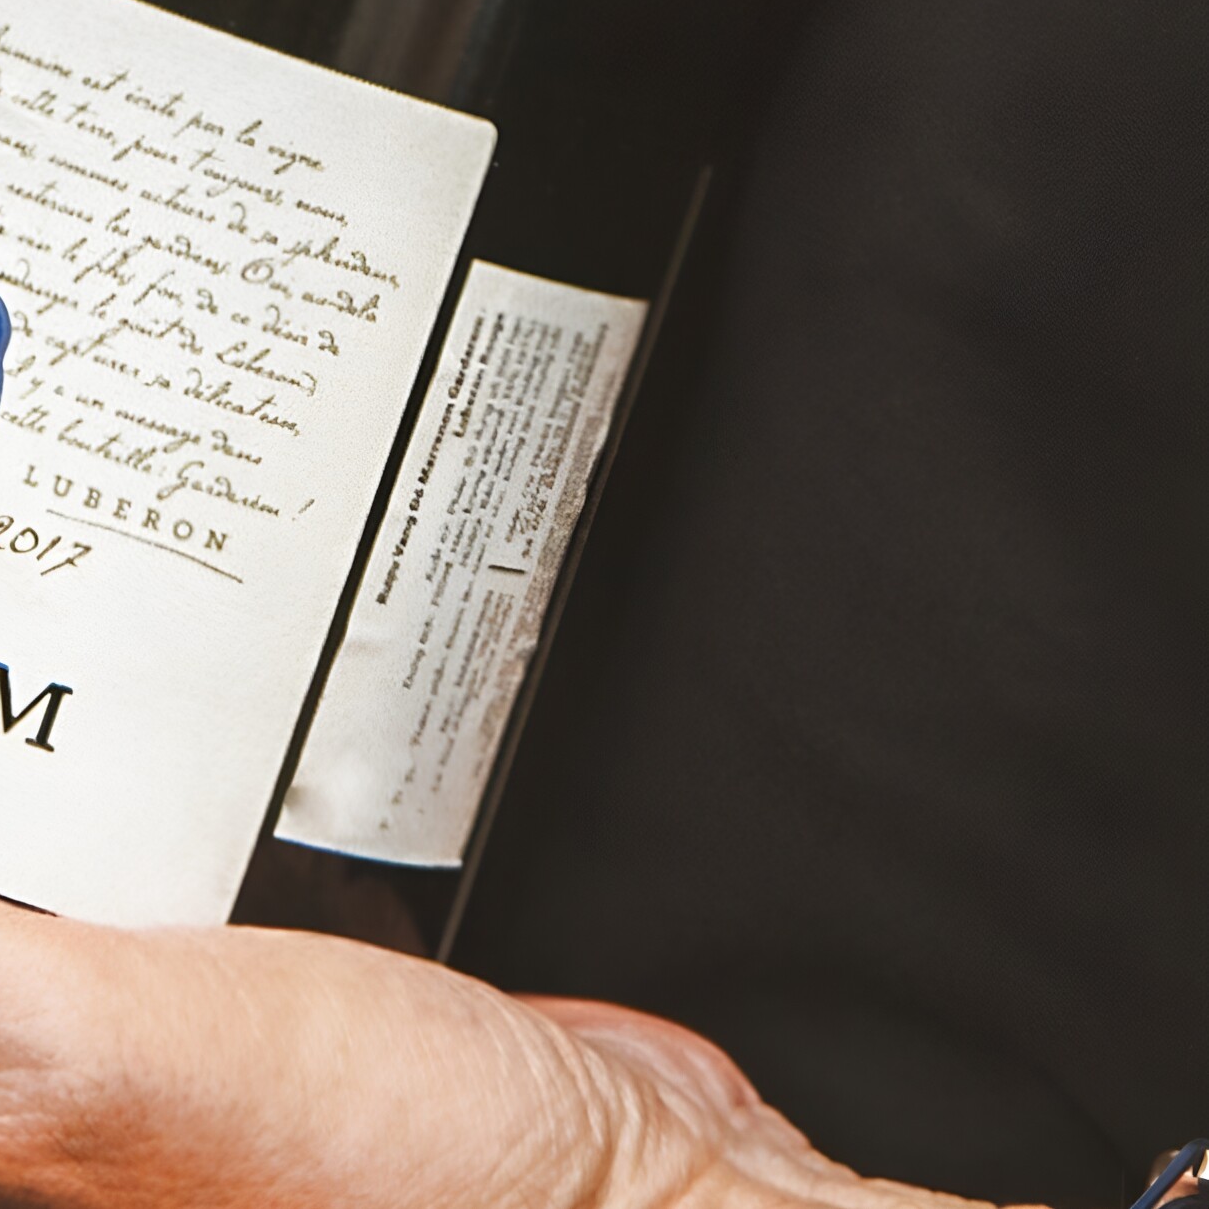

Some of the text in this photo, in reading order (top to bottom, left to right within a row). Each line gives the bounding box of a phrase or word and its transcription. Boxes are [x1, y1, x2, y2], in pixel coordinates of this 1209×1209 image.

[80, 69, 130, 93] est
[172, 111, 226, 154] par
[234, 118, 264, 149] la
[110, 134, 179, 166] pour
[225, 200, 250, 236] de
[22, 463, 230, 553] LUBERON
